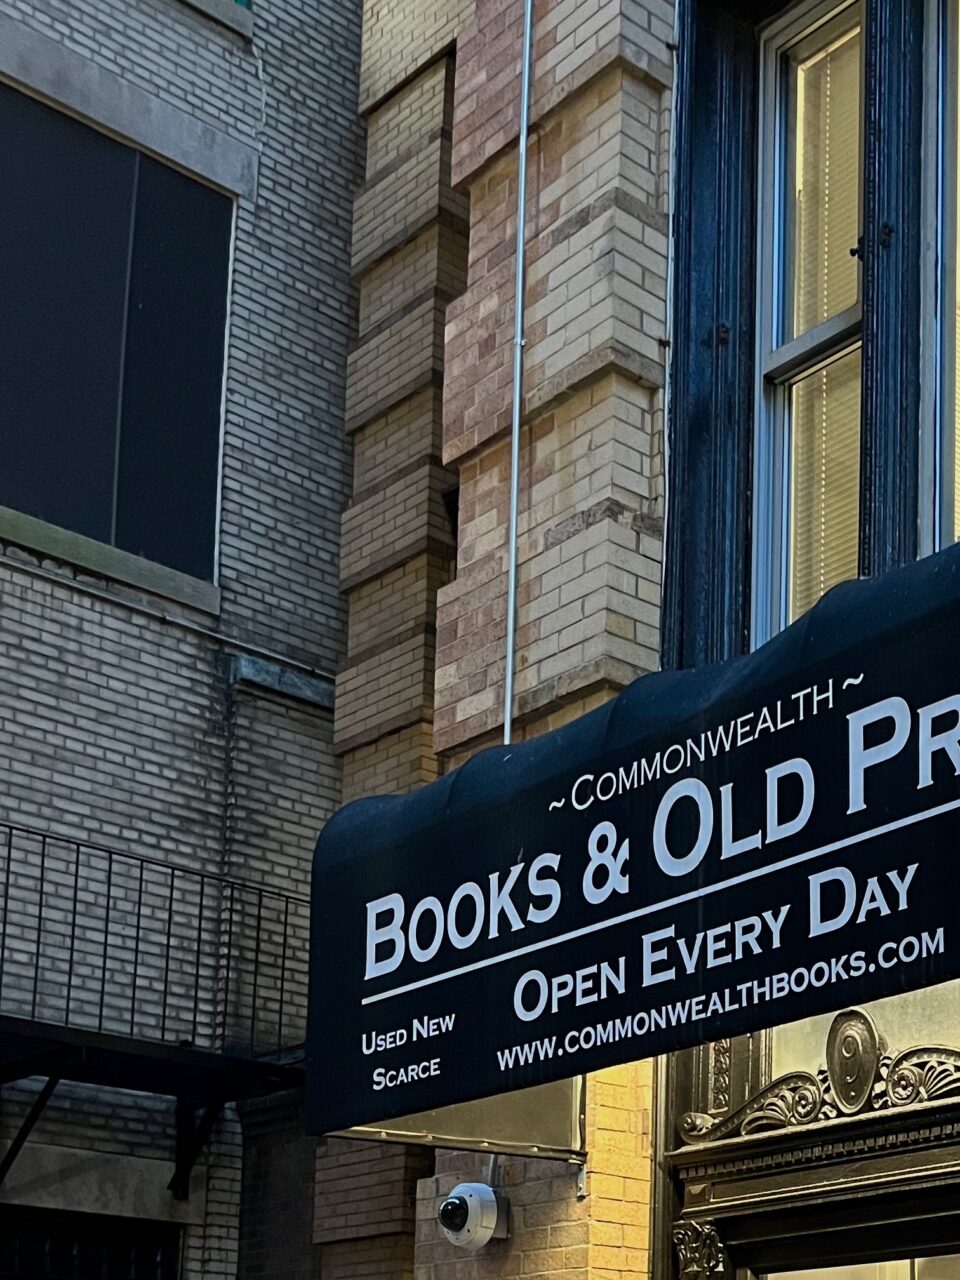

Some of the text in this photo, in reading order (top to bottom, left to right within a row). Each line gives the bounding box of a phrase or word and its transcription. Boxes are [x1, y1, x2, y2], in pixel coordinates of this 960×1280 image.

[363, 852, 562, 981] BOOKS
[582, 820, 630, 905] &
[652, 757, 816, 878] OLD
[513, 862, 920, 1022] OPEN EVERY DAY
[361, 1013, 456, 1055] USED NEW
[372, 1058, 441, 1091] SCARCE
